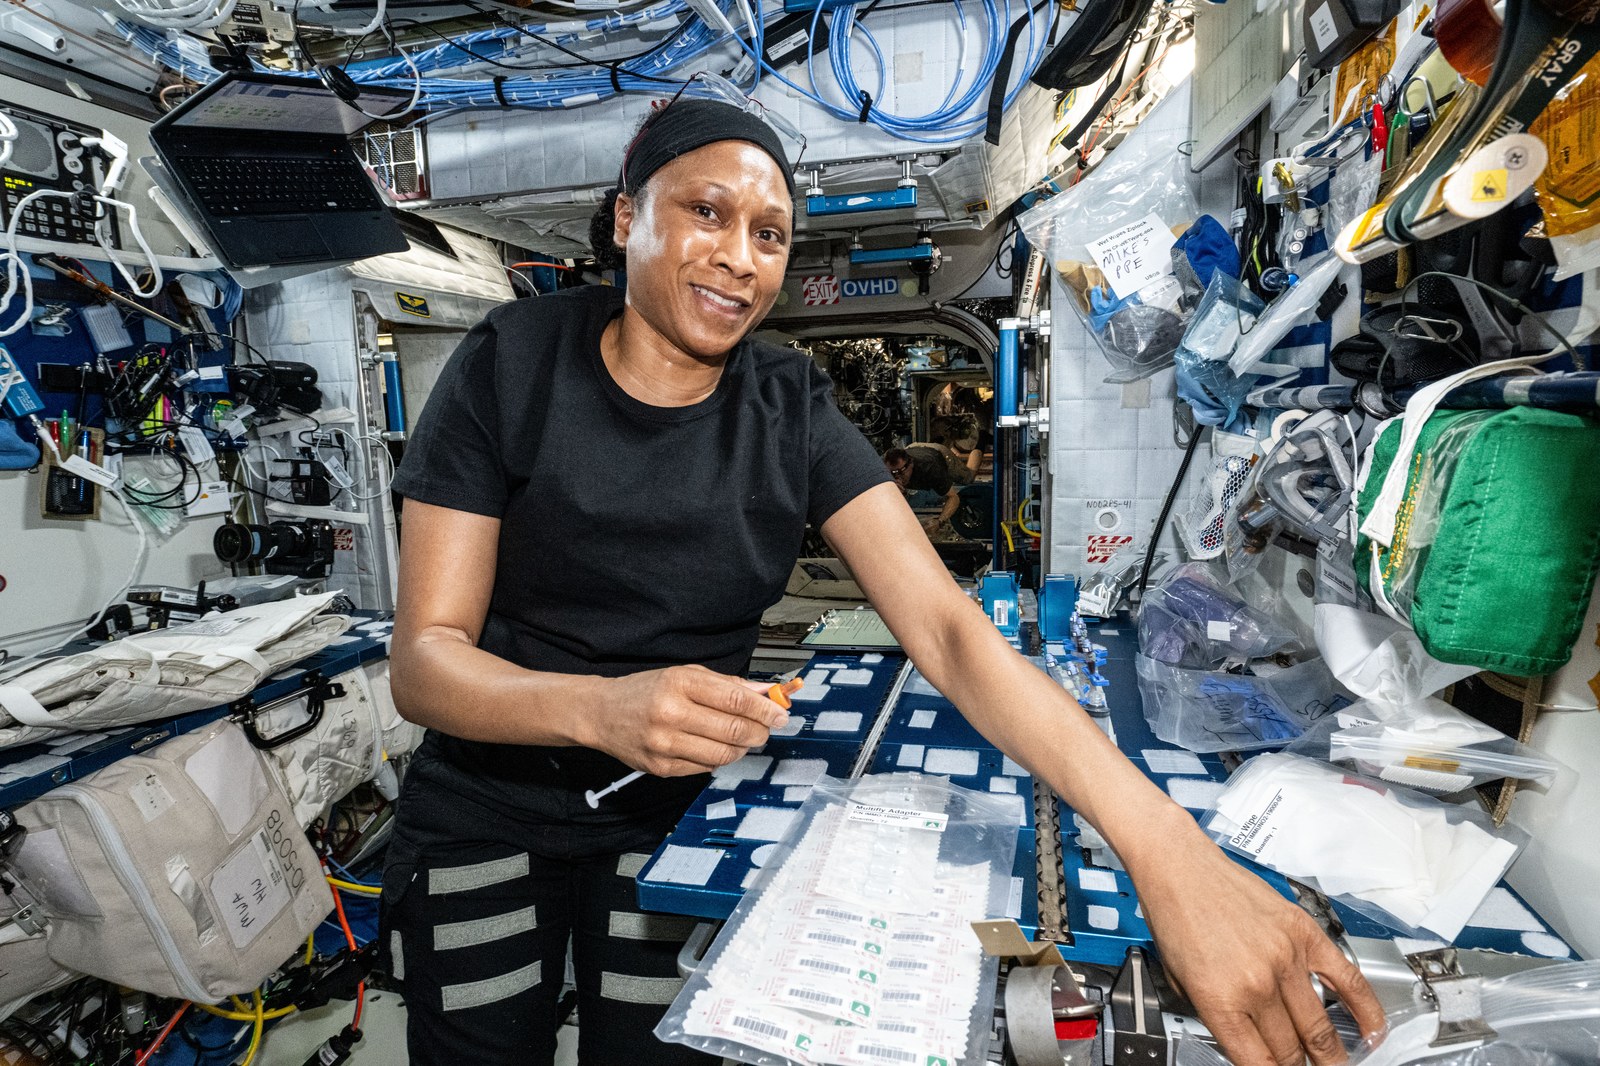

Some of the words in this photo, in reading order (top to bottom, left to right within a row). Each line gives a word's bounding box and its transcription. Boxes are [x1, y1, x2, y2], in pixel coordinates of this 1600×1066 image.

[1534, 37, 1568, 79] TAPE
[1540, 39, 1582, 88] GRAY
[1097, 238, 1109, 247] Wet
[1109, 230, 1127, 241] Wipes
[1116, 256, 1143, 279] PPE
[808, 282, 833, 299] EXIT
[843, 278, 898, 296] OVHD
[1023, 284, 1032, 296] Fire
[855, 805, 886, 813] Multifly
[888, 808, 921, 816] Adapter
[1232, 831, 1247, 845] Dry
[1240, 814, 1258, 831] Wipe
[1242, 839, 1252, 848] P/N
[1254, 833, 1274, 854] Quantity
[251, 878, 268, 905] H/W
[232, 892, 256, 928] MWA
